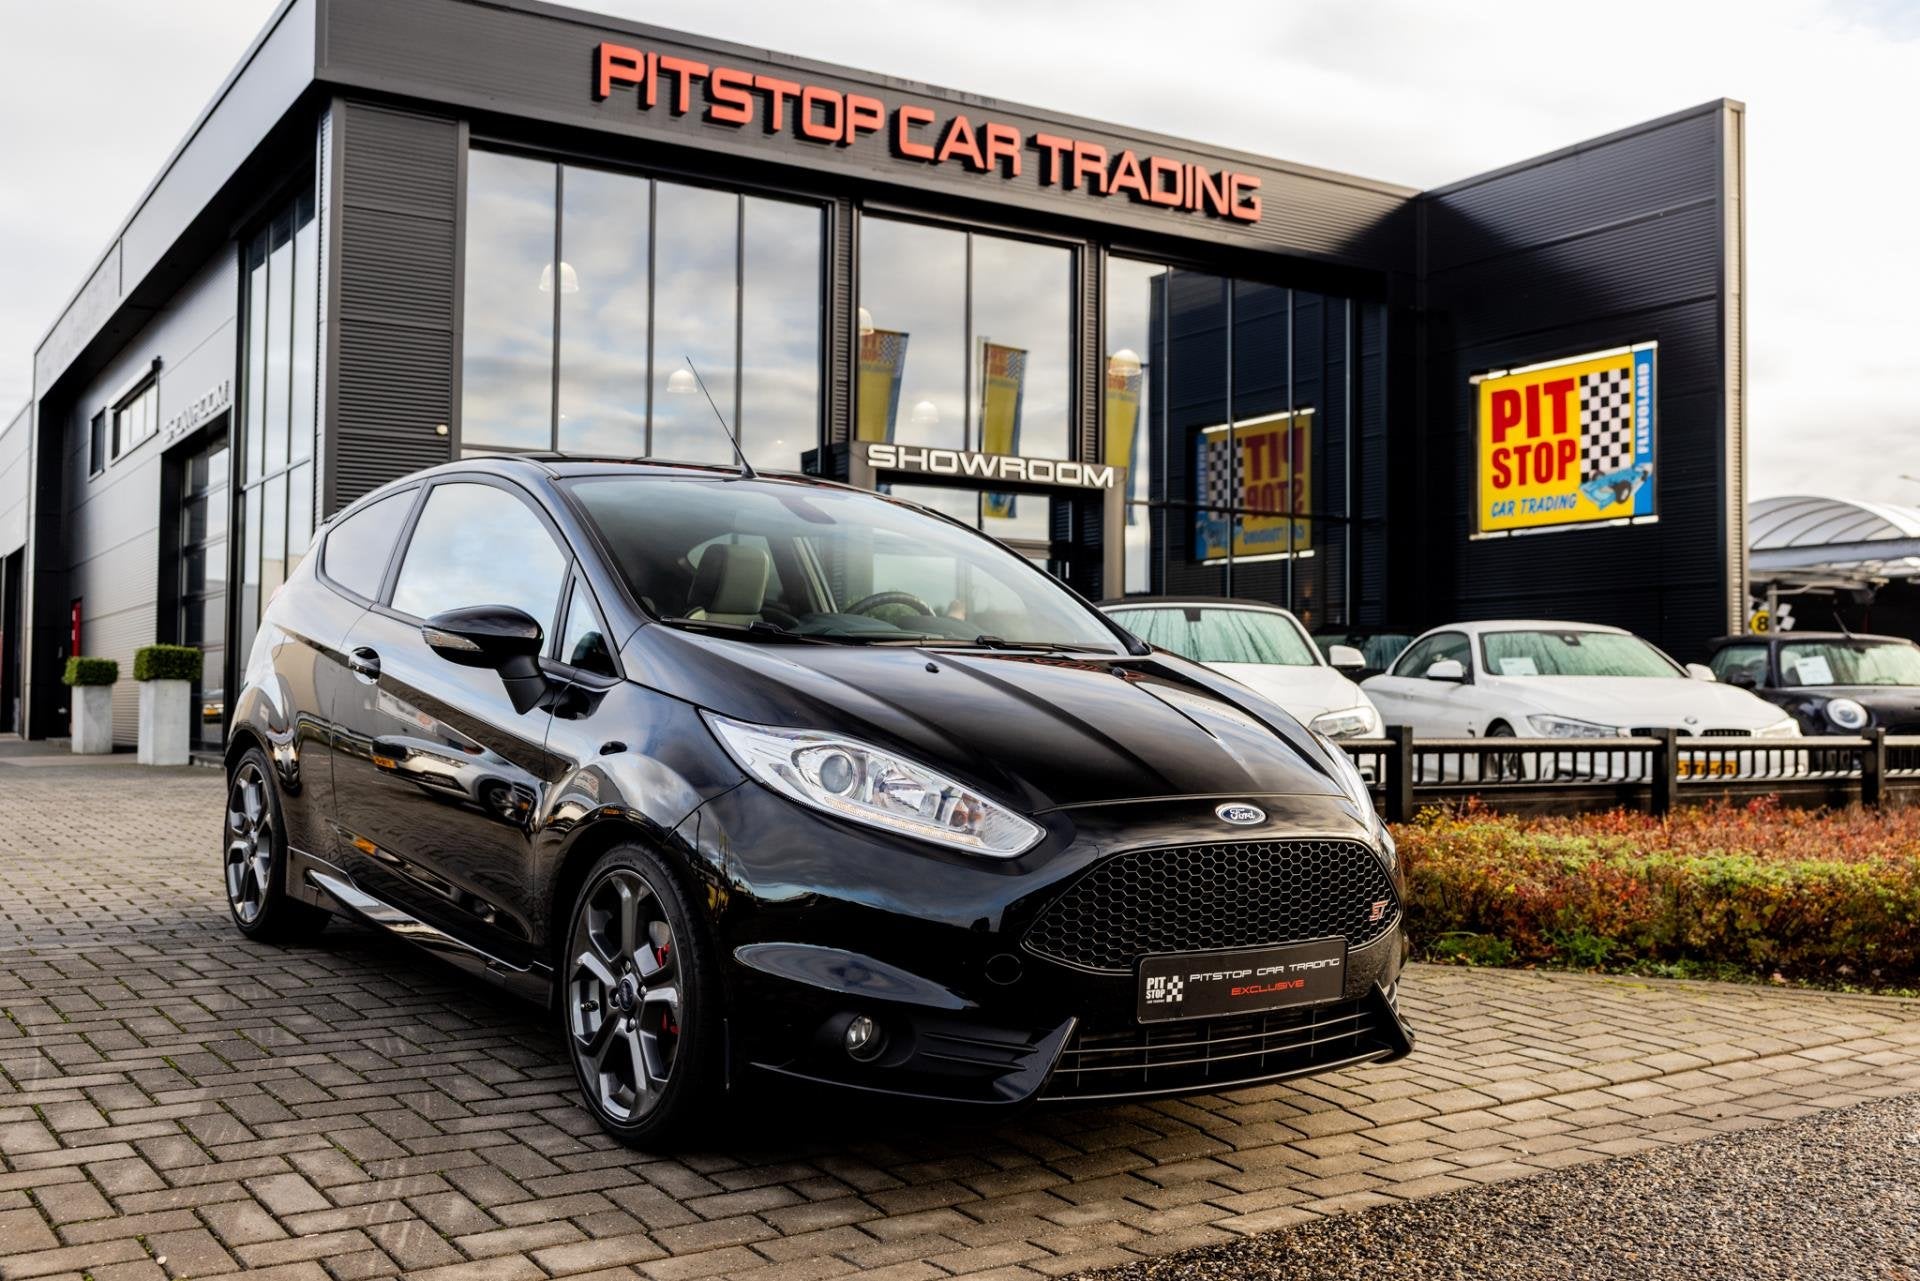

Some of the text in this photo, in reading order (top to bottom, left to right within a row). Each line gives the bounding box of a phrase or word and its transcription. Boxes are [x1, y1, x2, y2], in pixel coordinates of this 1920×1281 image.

[600, 43, 1261, 223] PITSTOP CAR TRADING
[1492, 379, 1574, 443] PIT
[1637, 363, 1649, 454] FLEVOLAND
[867, 444, 1114, 489] SHOWROOM
[1492, 439, 1577, 490] STOP
[1491, 493, 1577, 517] CAR TRADING
[1229, 808, 1256, 820] Ford
[1369, 900, 1388, 921] ST
[1190, 958, 1340, 982] PITSTOP CAR TRADING
[1145, 988, 1166, 1000] STOP
[1146, 976, 1167, 990] PIT
[1231, 980, 1304, 995] EXCLUSIVE
